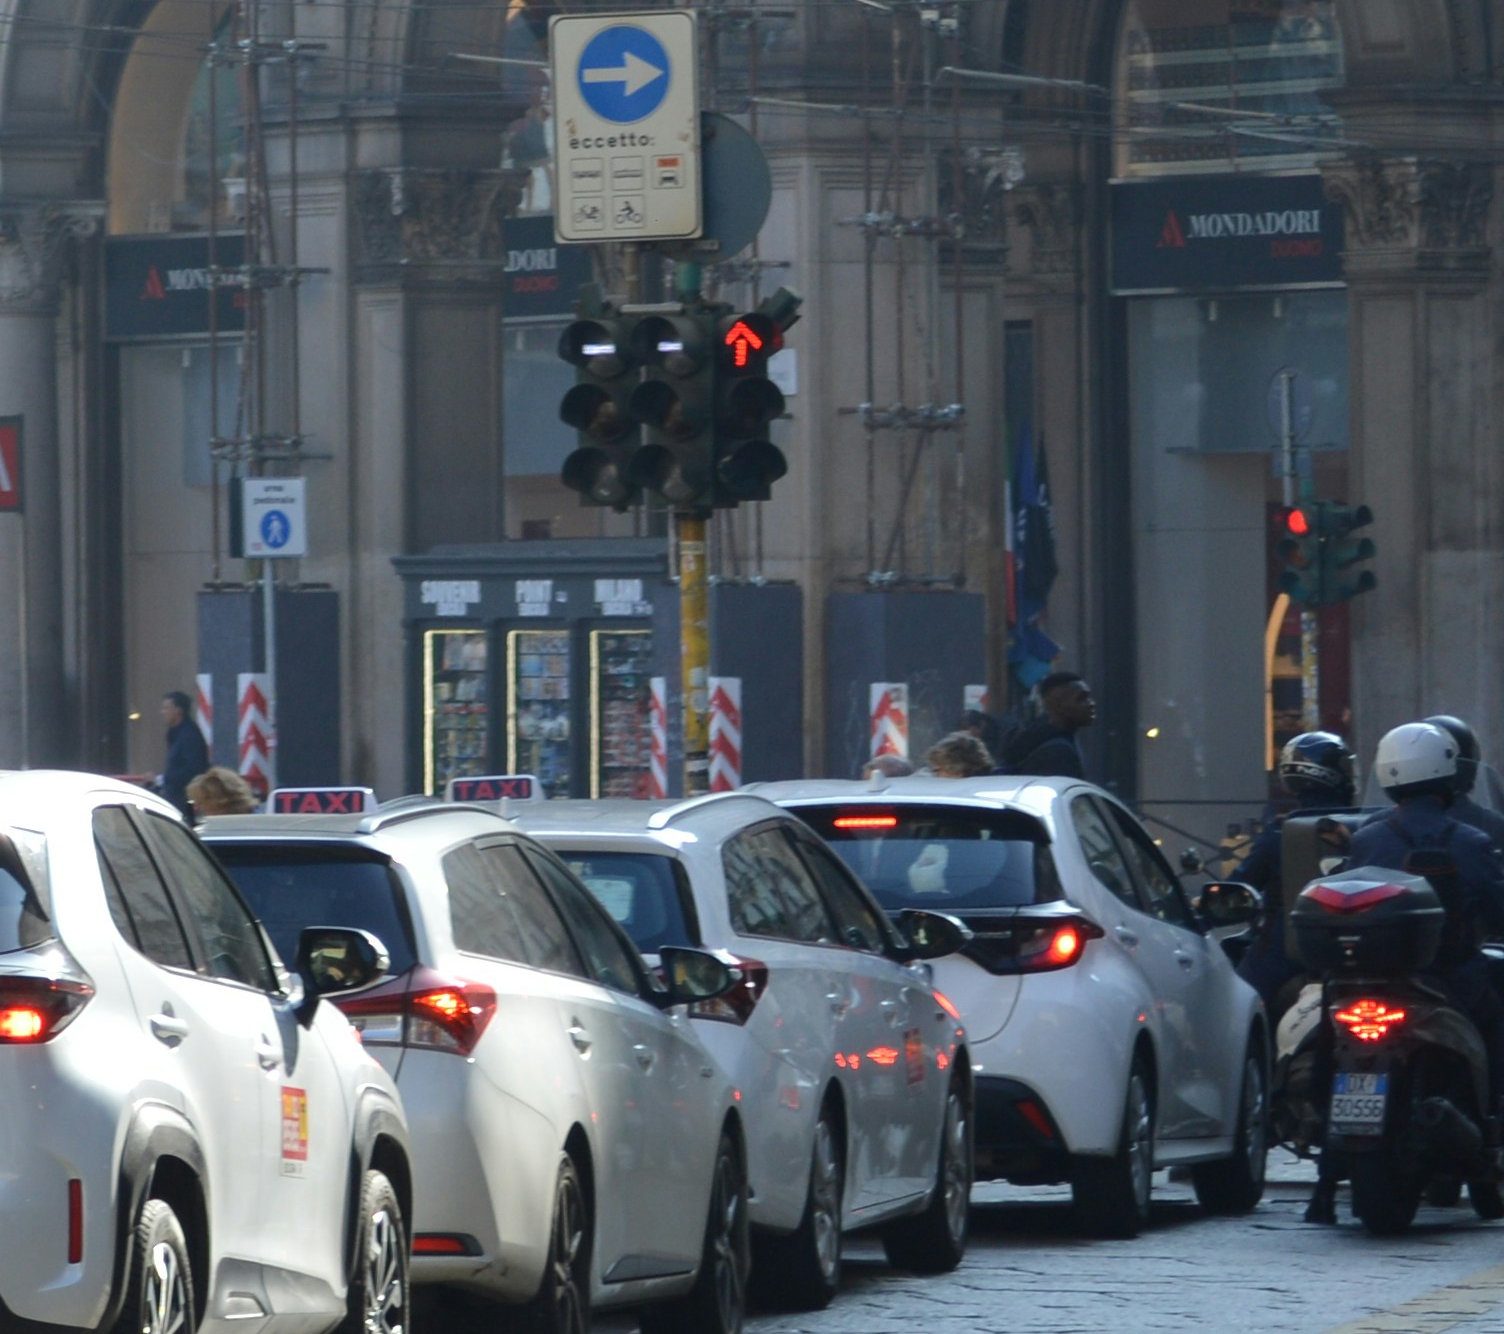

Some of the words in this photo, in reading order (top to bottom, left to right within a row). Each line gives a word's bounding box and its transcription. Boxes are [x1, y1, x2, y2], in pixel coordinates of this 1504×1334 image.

[1187, 210, 1321, 238] MONDADORI
[454, 780, 530, 801] TAXI
[276, 792, 362, 814] TAXI
